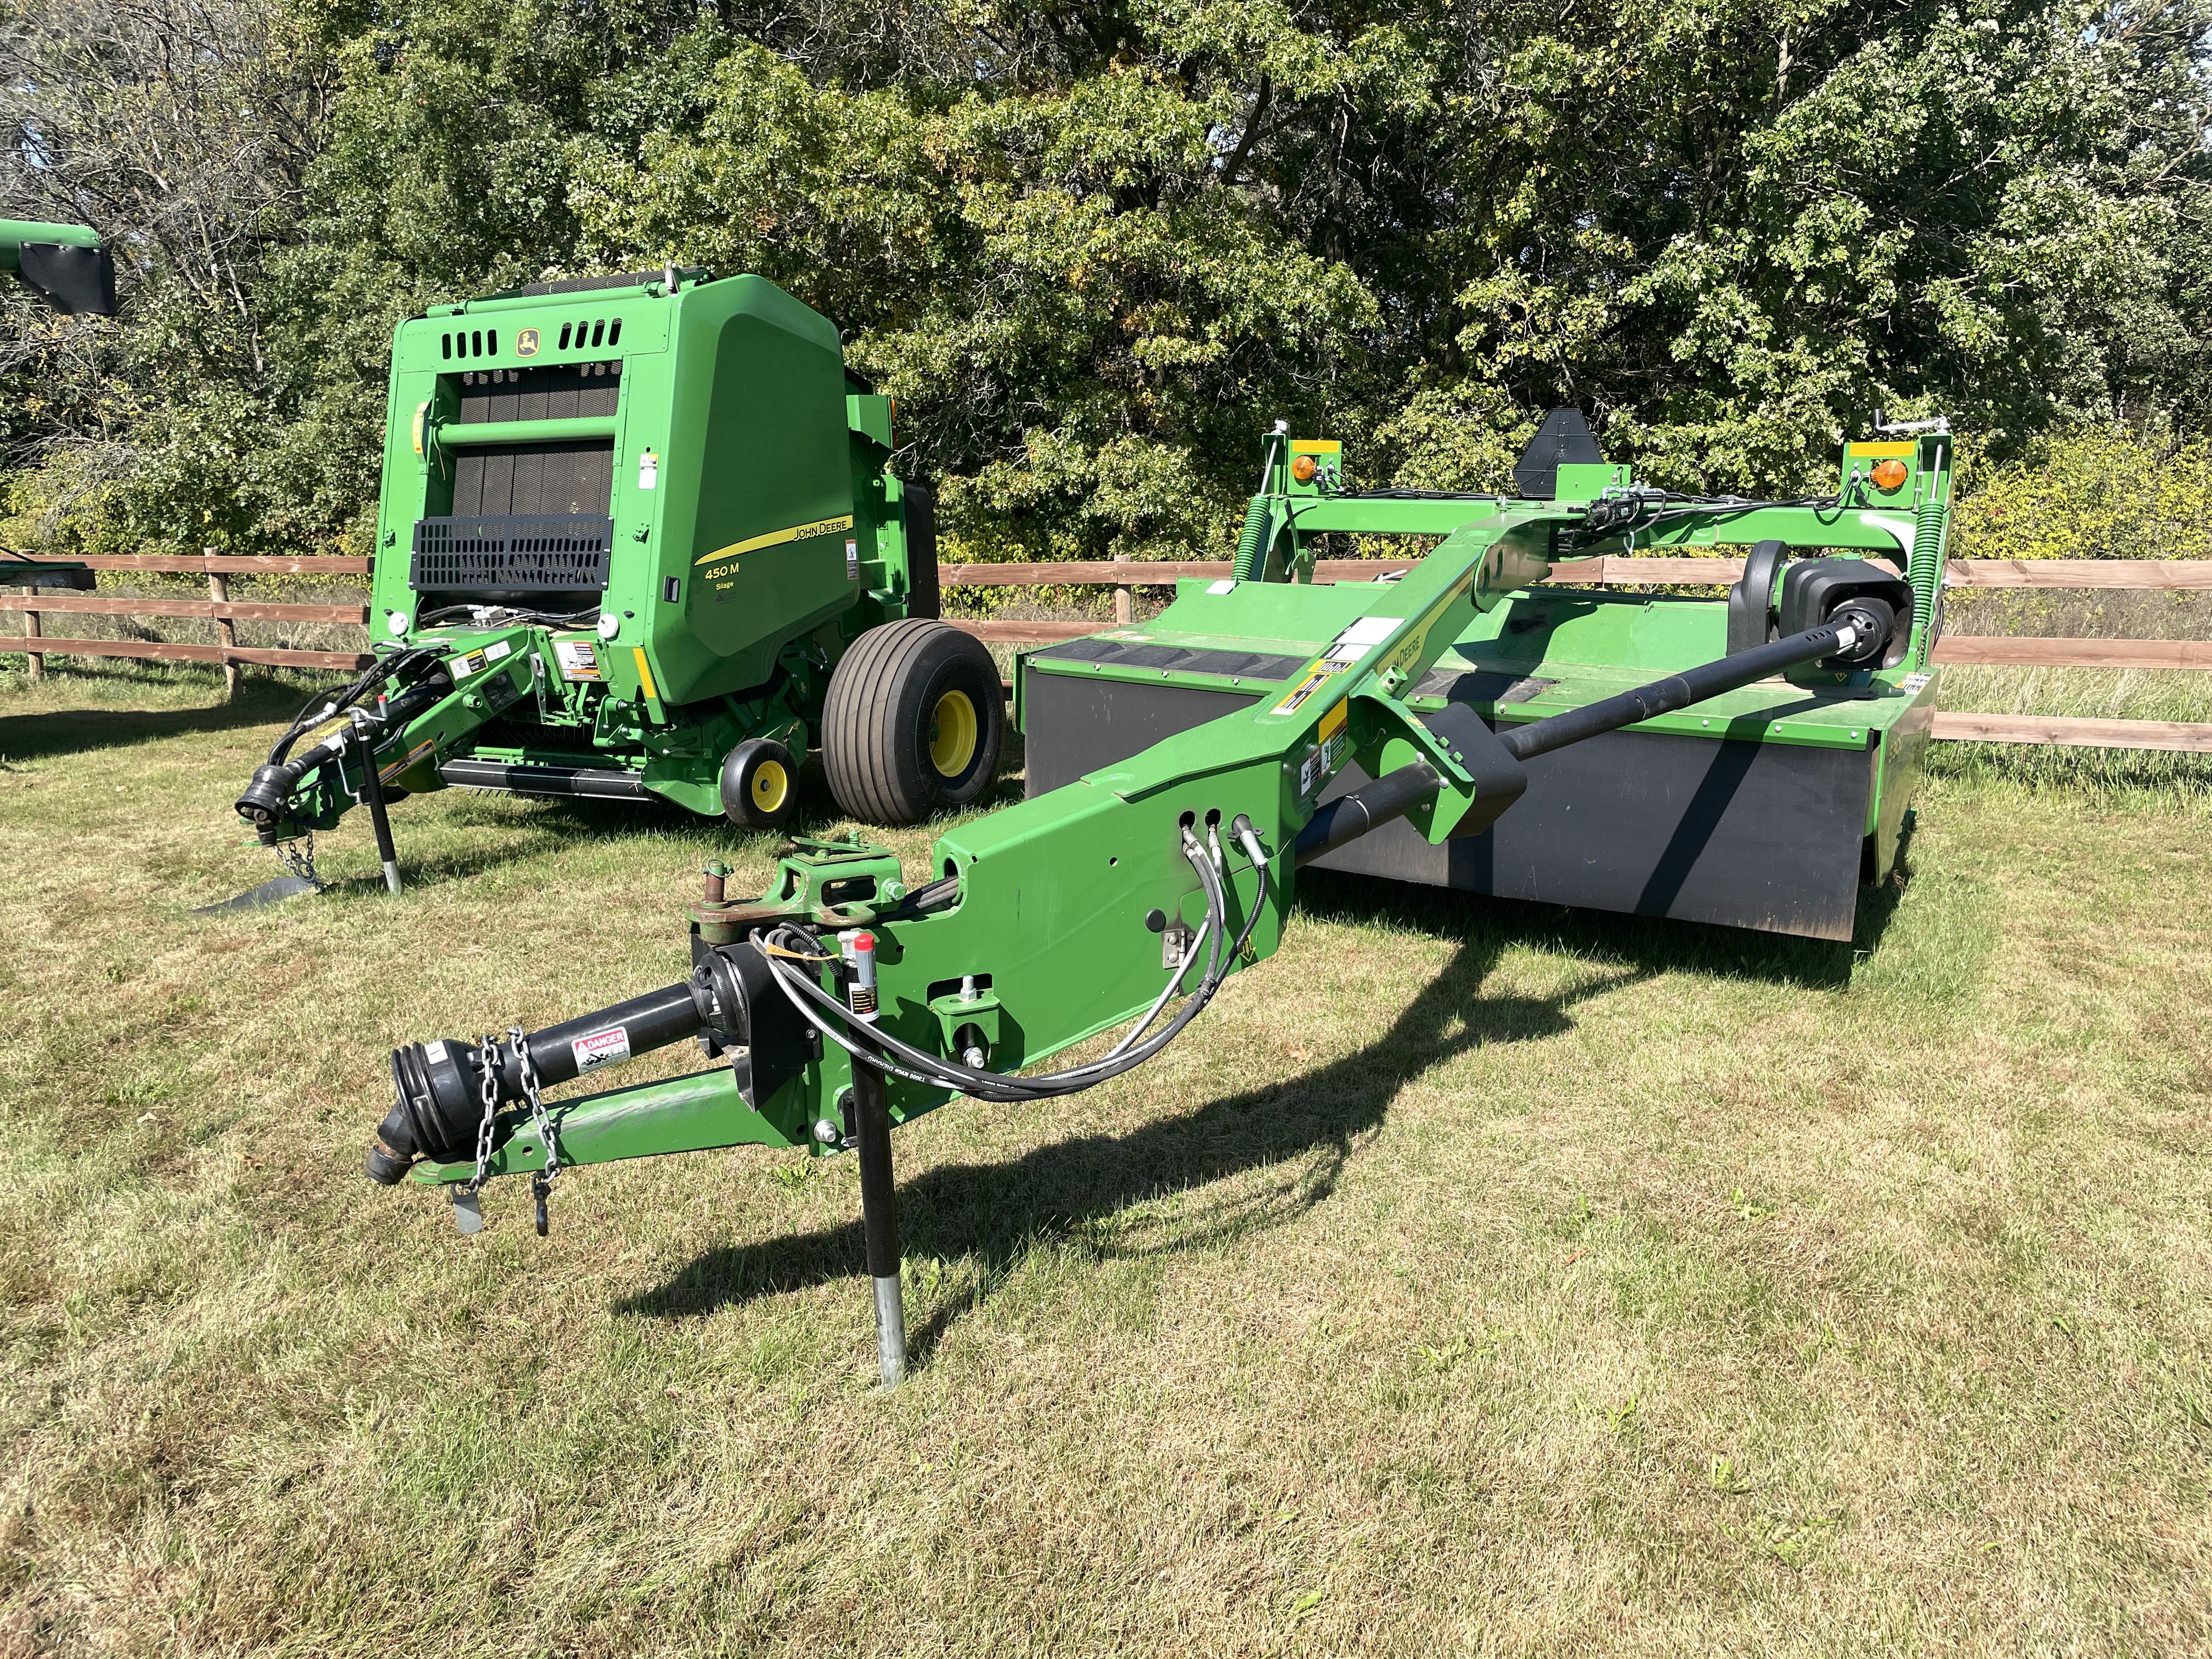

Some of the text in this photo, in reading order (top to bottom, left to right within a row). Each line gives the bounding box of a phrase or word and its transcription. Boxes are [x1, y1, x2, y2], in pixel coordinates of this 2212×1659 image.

[794, 521, 847, 540] JOHN DEERE
[705, 562, 739, 580] 450 M
[716, 582, 733, 590] Silage
[1400, 635, 1420, 668] DEERE
[587, 1031, 624, 1050] DANGER
